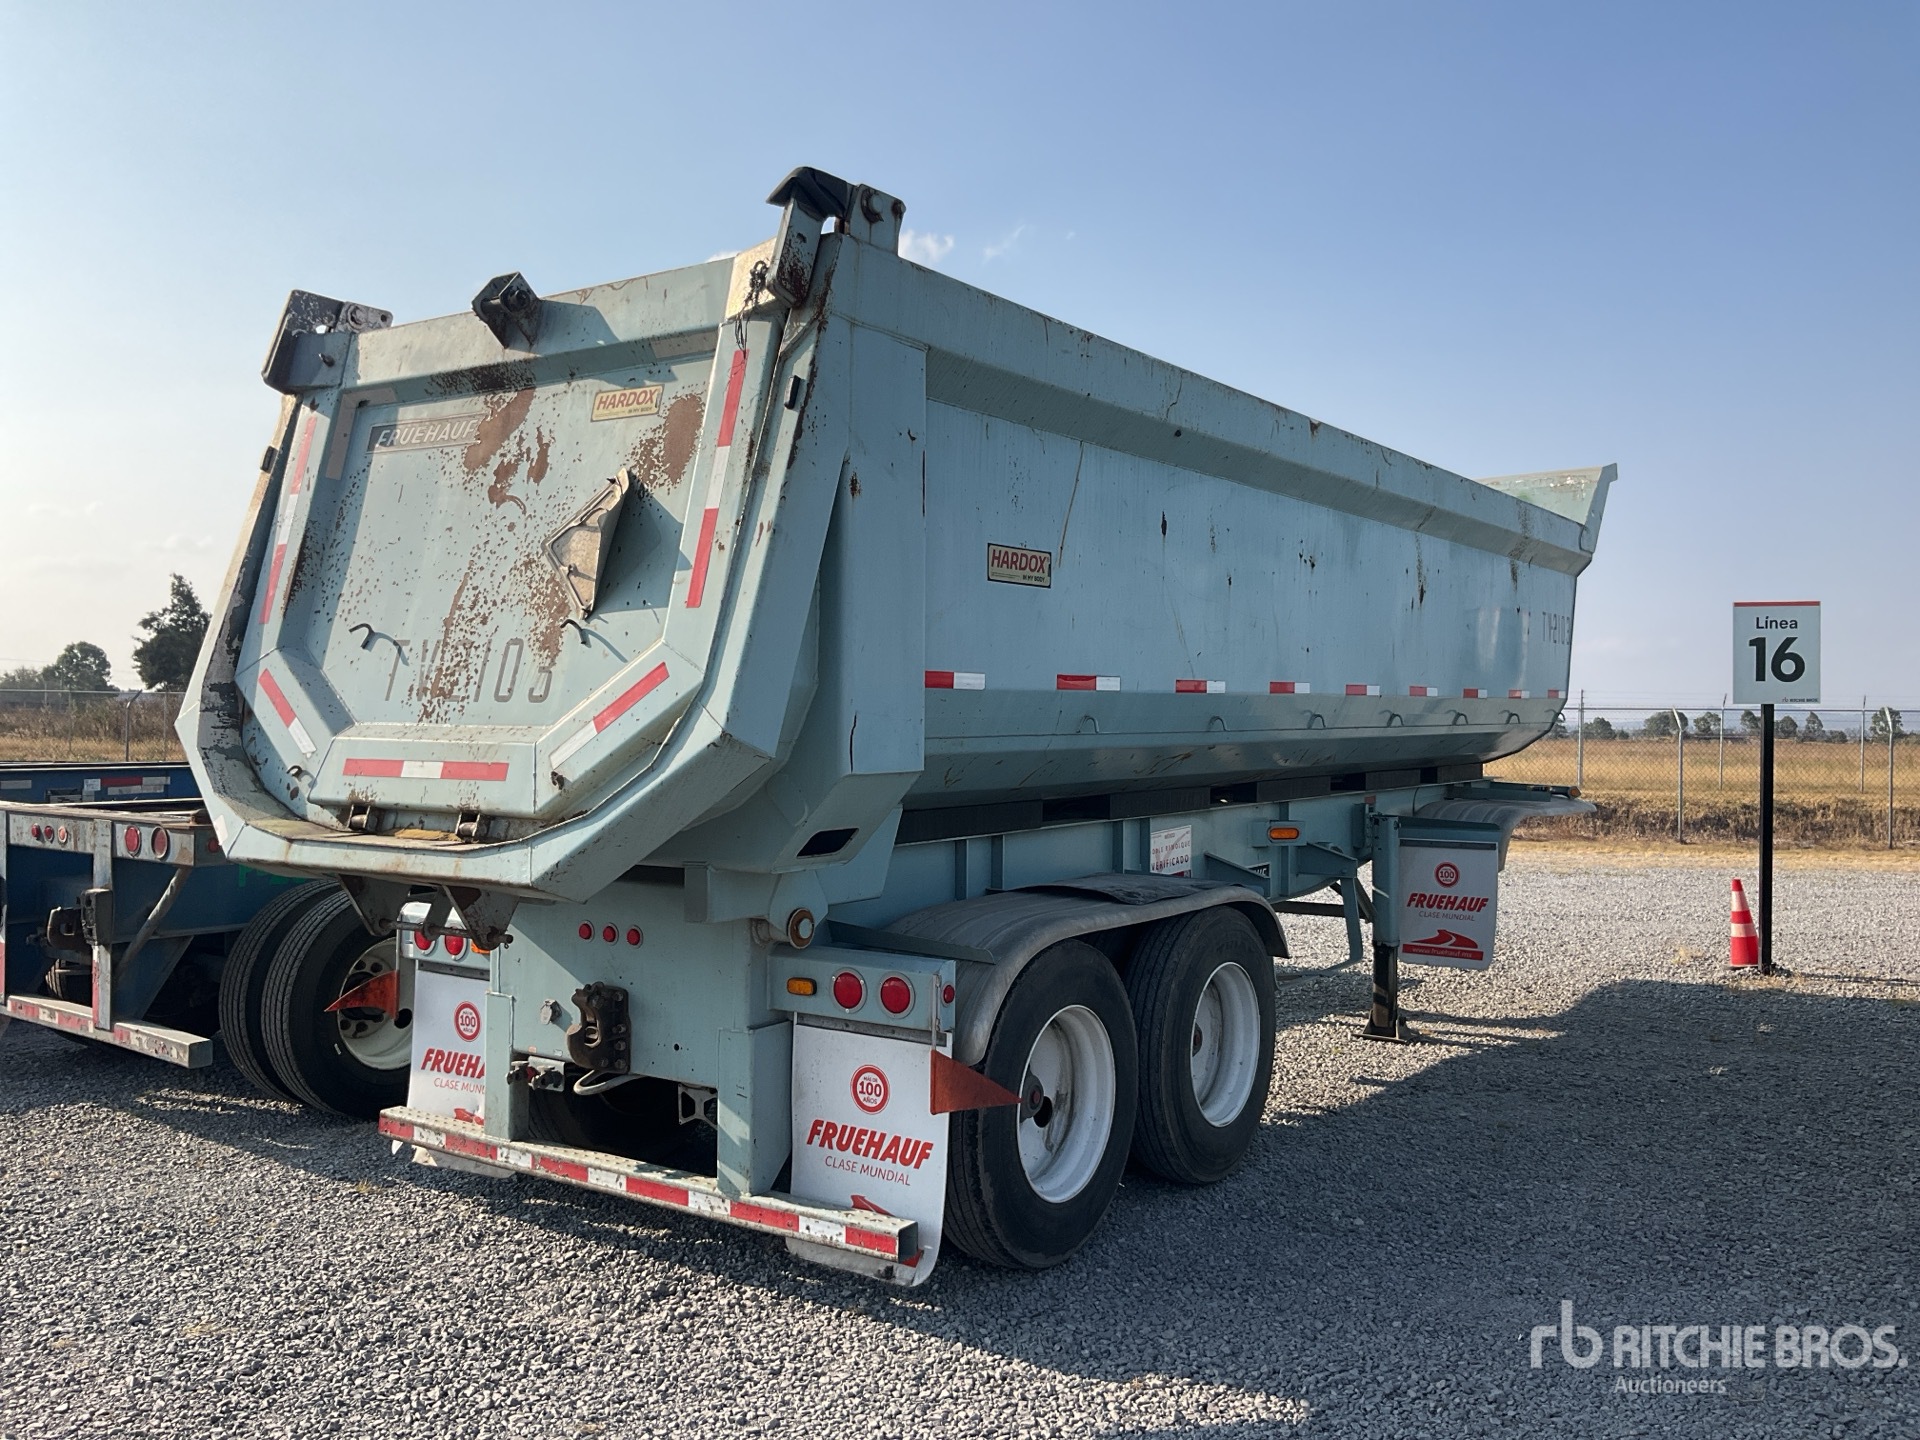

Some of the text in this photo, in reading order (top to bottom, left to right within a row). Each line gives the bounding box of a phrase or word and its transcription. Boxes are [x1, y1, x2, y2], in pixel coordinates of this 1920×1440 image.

[597, 389, 657, 410] HARDOX
[376, 419, 478, 448] FRUEHAUF
[991, 549, 1046, 574] HARDOX
[1756, 616, 1798, 629] Línea
[1749, 637, 1805, 683] 16
[1440, 870, 1455, 880] 100
[1407, 893, 1489, 912] FRUEHAUF
[1419, 910, 1476, 922] CLASE MUNDIAL
[460, 1015, 476, 1027] 100
[434, 1078, 459, 1091] CLASE
[858, 1081, 883, 1098] 100
[862, 1096, 878, 1105] AÑOS
[806, 1119, 934, 1170] FRUEHAUF
[825, 1155, 911, 1187] CLASE MUNDIAL
